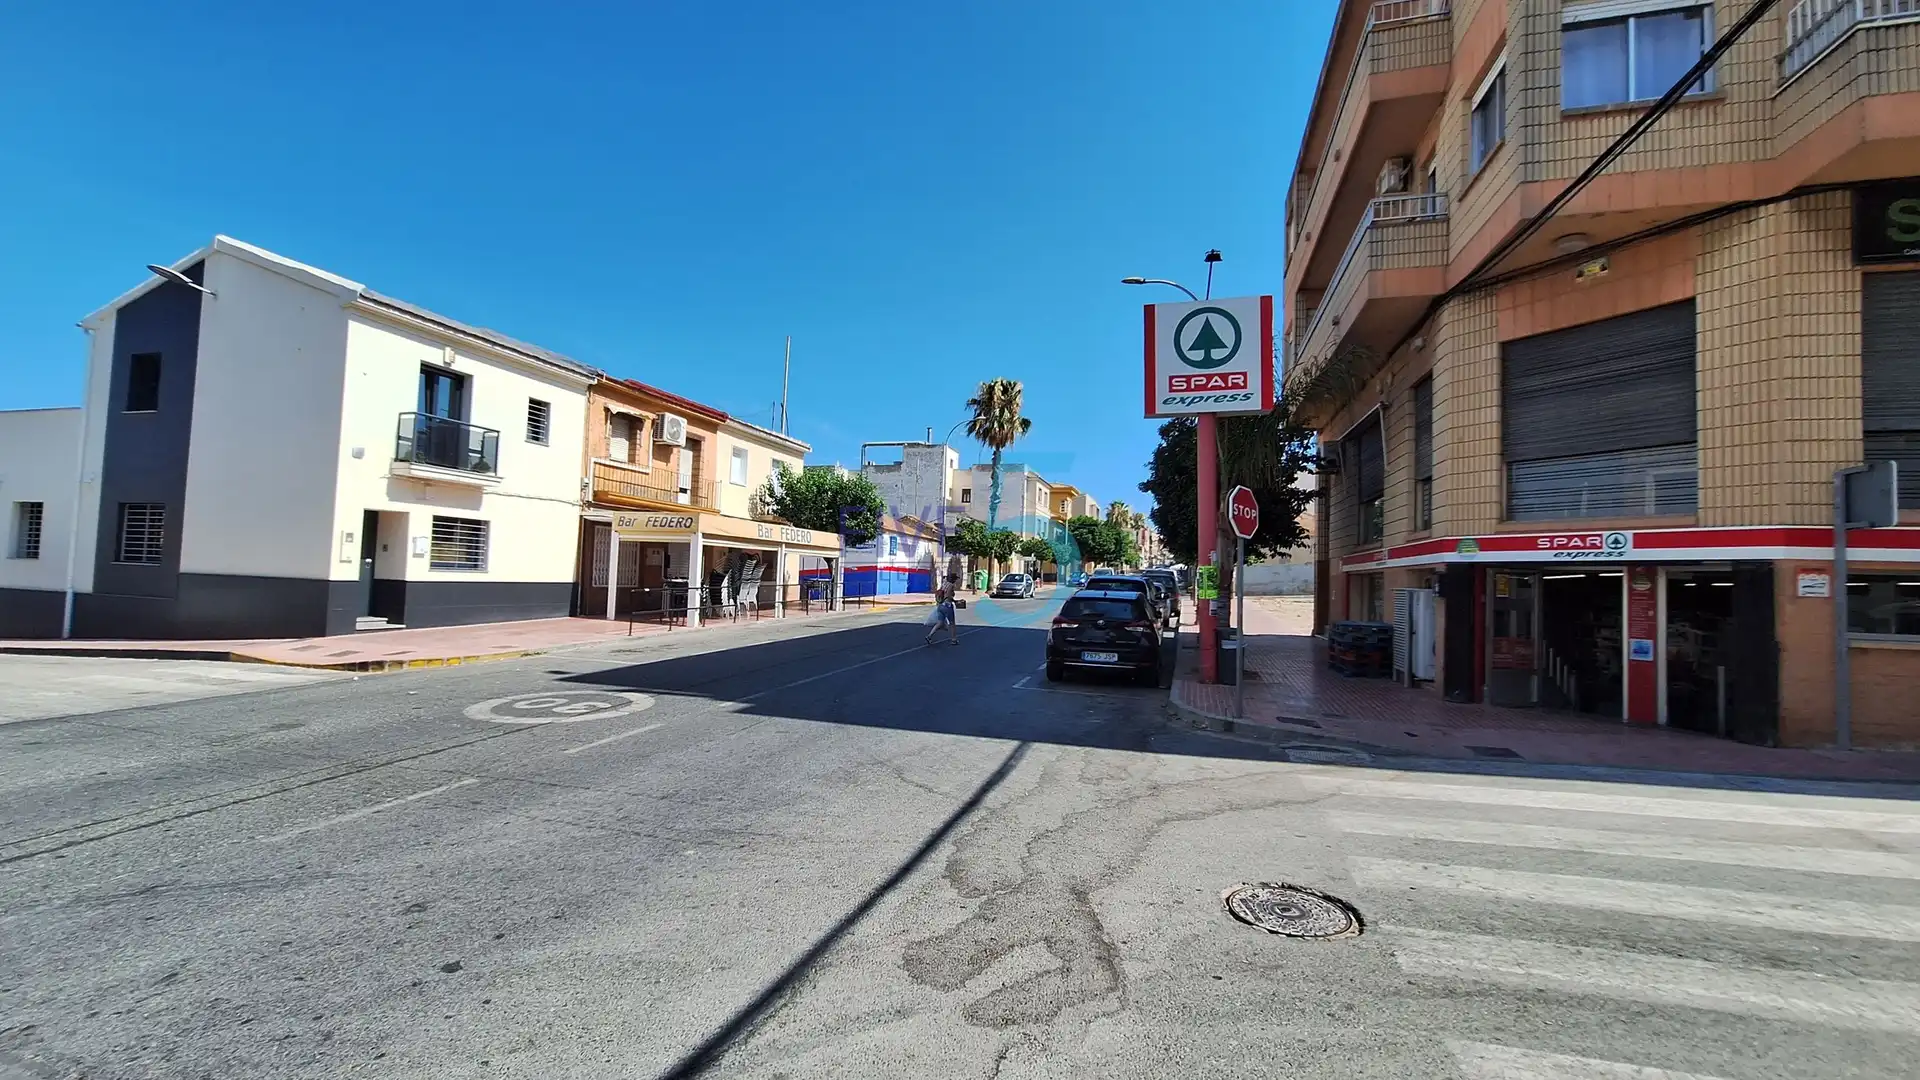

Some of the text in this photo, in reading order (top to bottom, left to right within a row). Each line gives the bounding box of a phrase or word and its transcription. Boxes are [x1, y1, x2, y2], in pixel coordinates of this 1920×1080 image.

[1171, 374, 1245, 390] SPAR
[1162, 392, 1255, 407] express
[1233, 503, 1257, 519] STOP
[617, 515, 694, 528] Bar FEDERO
[757, 523, 812, 543] Bar FEDERO
[1537, 536, 1602, 548] SPAR
[1553, 551, 1627, 559] express
